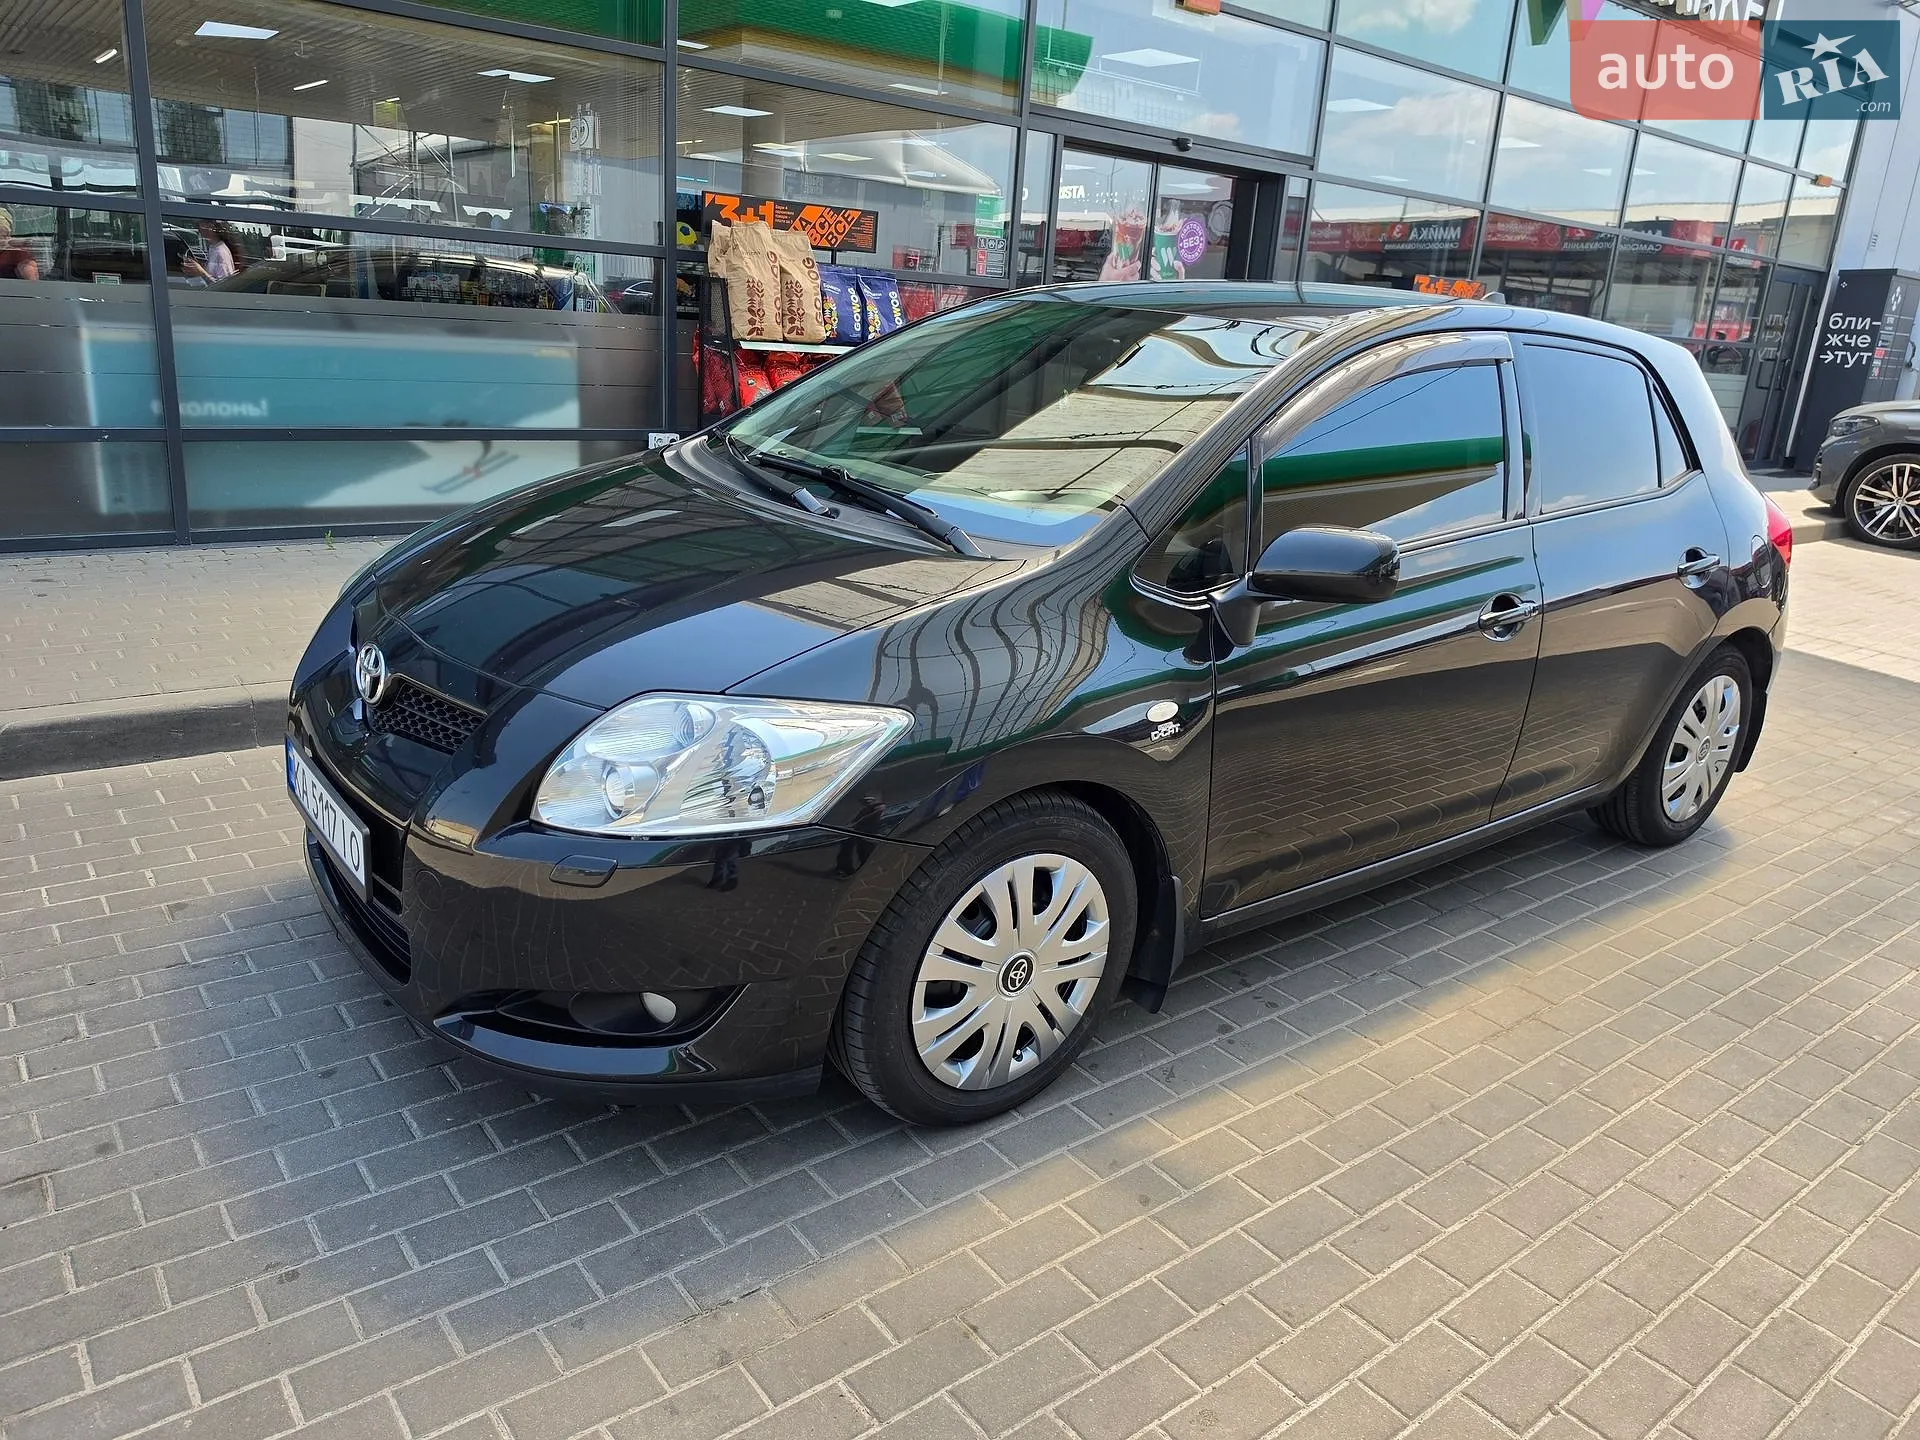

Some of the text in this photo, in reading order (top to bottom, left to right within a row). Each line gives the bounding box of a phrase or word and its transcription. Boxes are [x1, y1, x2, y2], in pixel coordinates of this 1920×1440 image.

[714, 195, 774, 229] 3+1
[824, 208, 855, 247] ВСЕ
[1183, 235, 1200, 249] БЕЗ
[848, 287, 861, 331] GOWOG
[1829, 312, 1882, 330] бли-
[1824, 333, 1872, 347] жче
[1836, 350, 1873, 368] тут
[311, 781, 337, 842] 5117
[342, 819, 360, 872] IO
